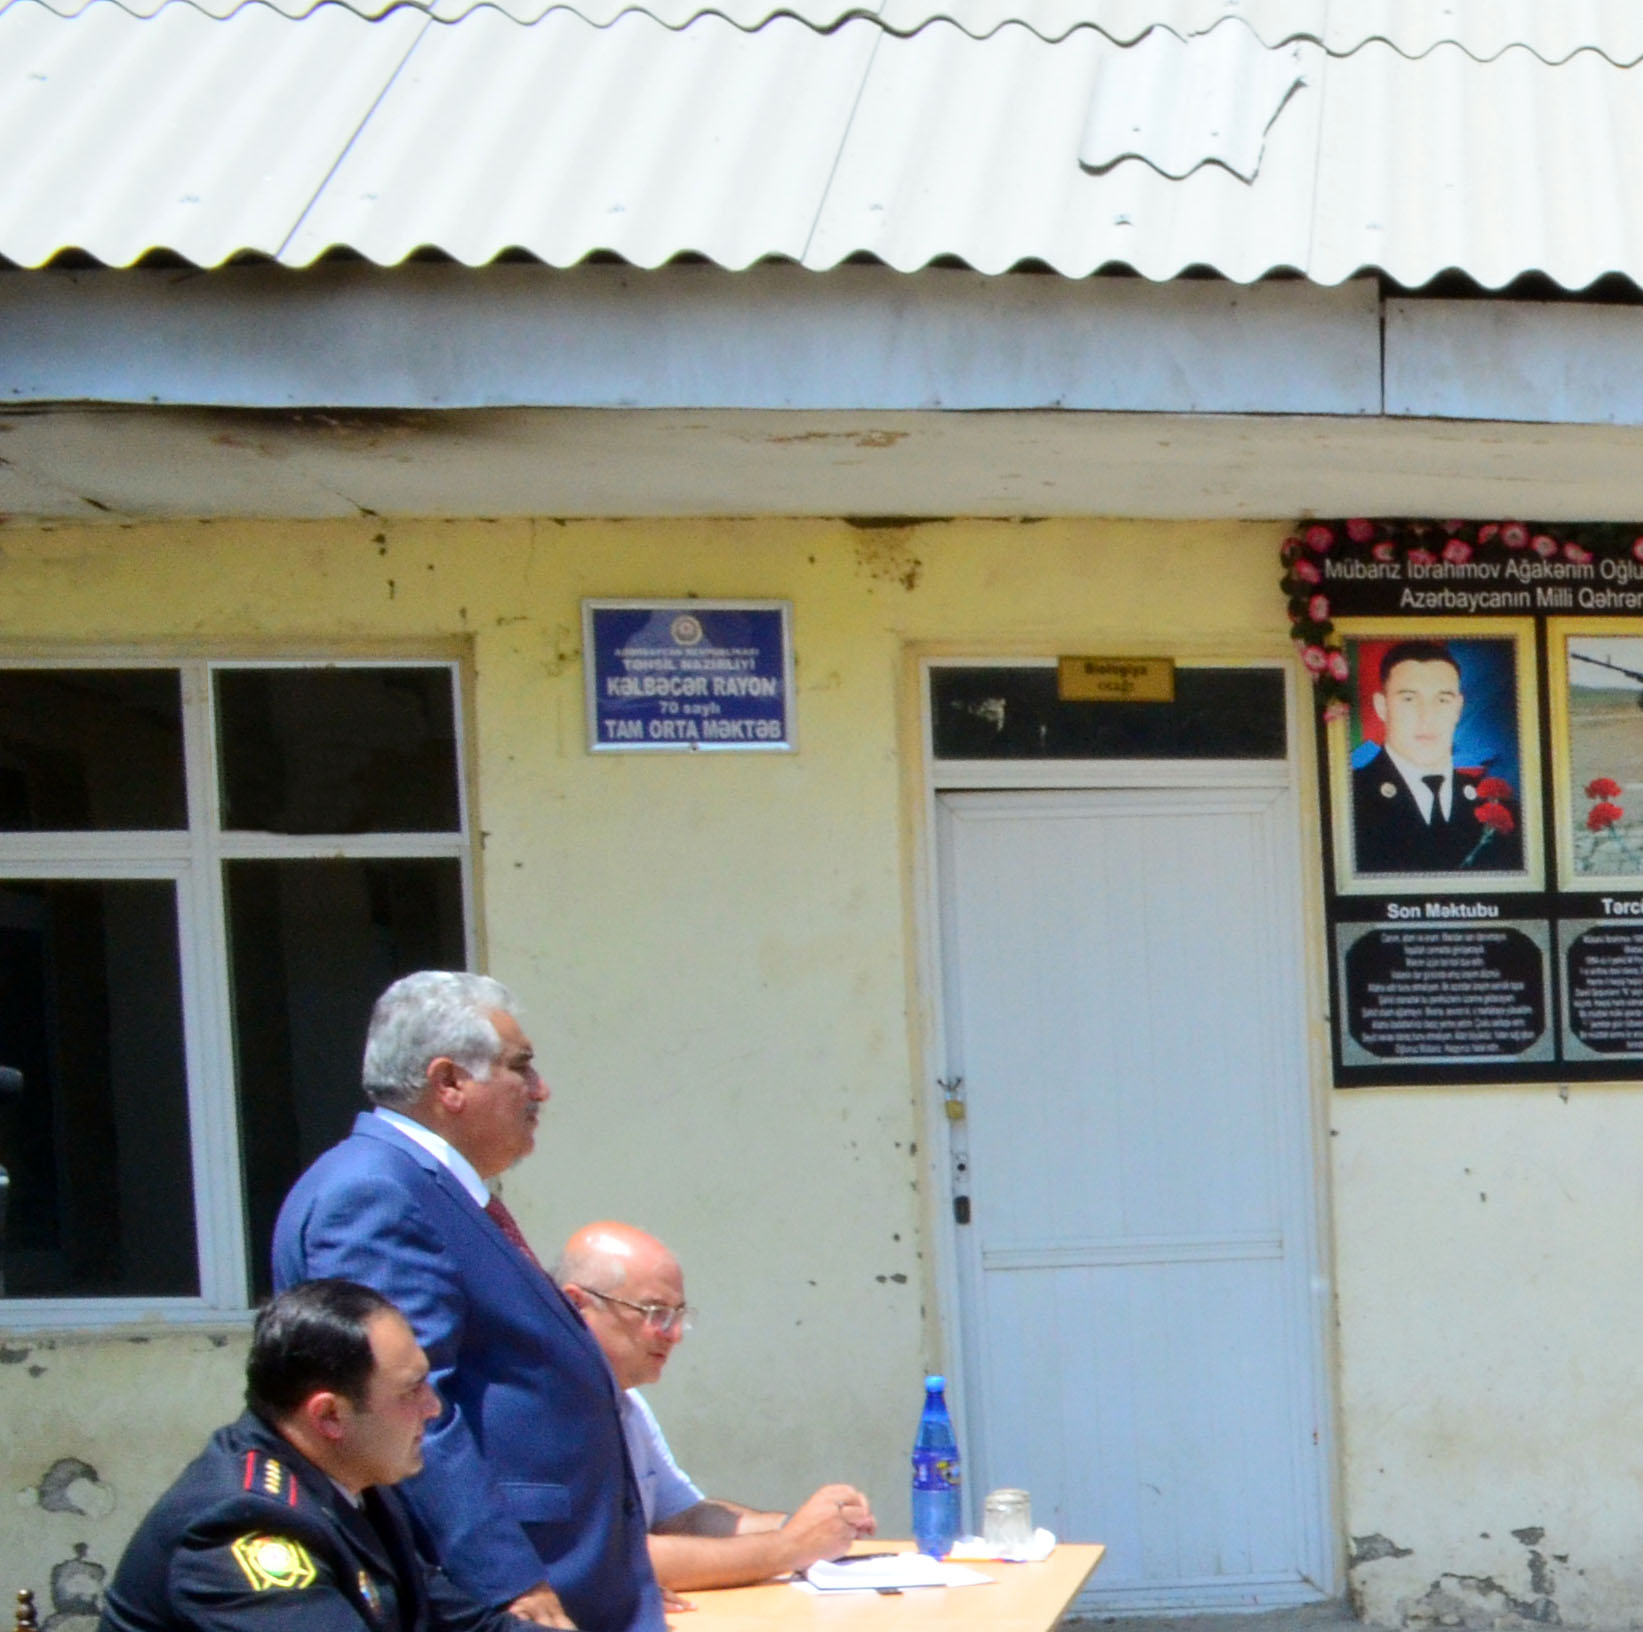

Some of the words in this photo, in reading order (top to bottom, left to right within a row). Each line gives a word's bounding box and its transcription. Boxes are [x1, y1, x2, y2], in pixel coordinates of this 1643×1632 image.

[1401, 587, 1531, 613] Azərbaycanın
[1536, 587, 1573, 608] Milli
[712, 677, 776, 696] RAYON
[604, 720, 644, 738] TAM
[651, 720, 699, 738] ORTA
[703, 720, 782, 738] MƏKTƏB
[1387, 904, 1421, 918] Son
[1425, 903, 1499, 917] Məktubu
